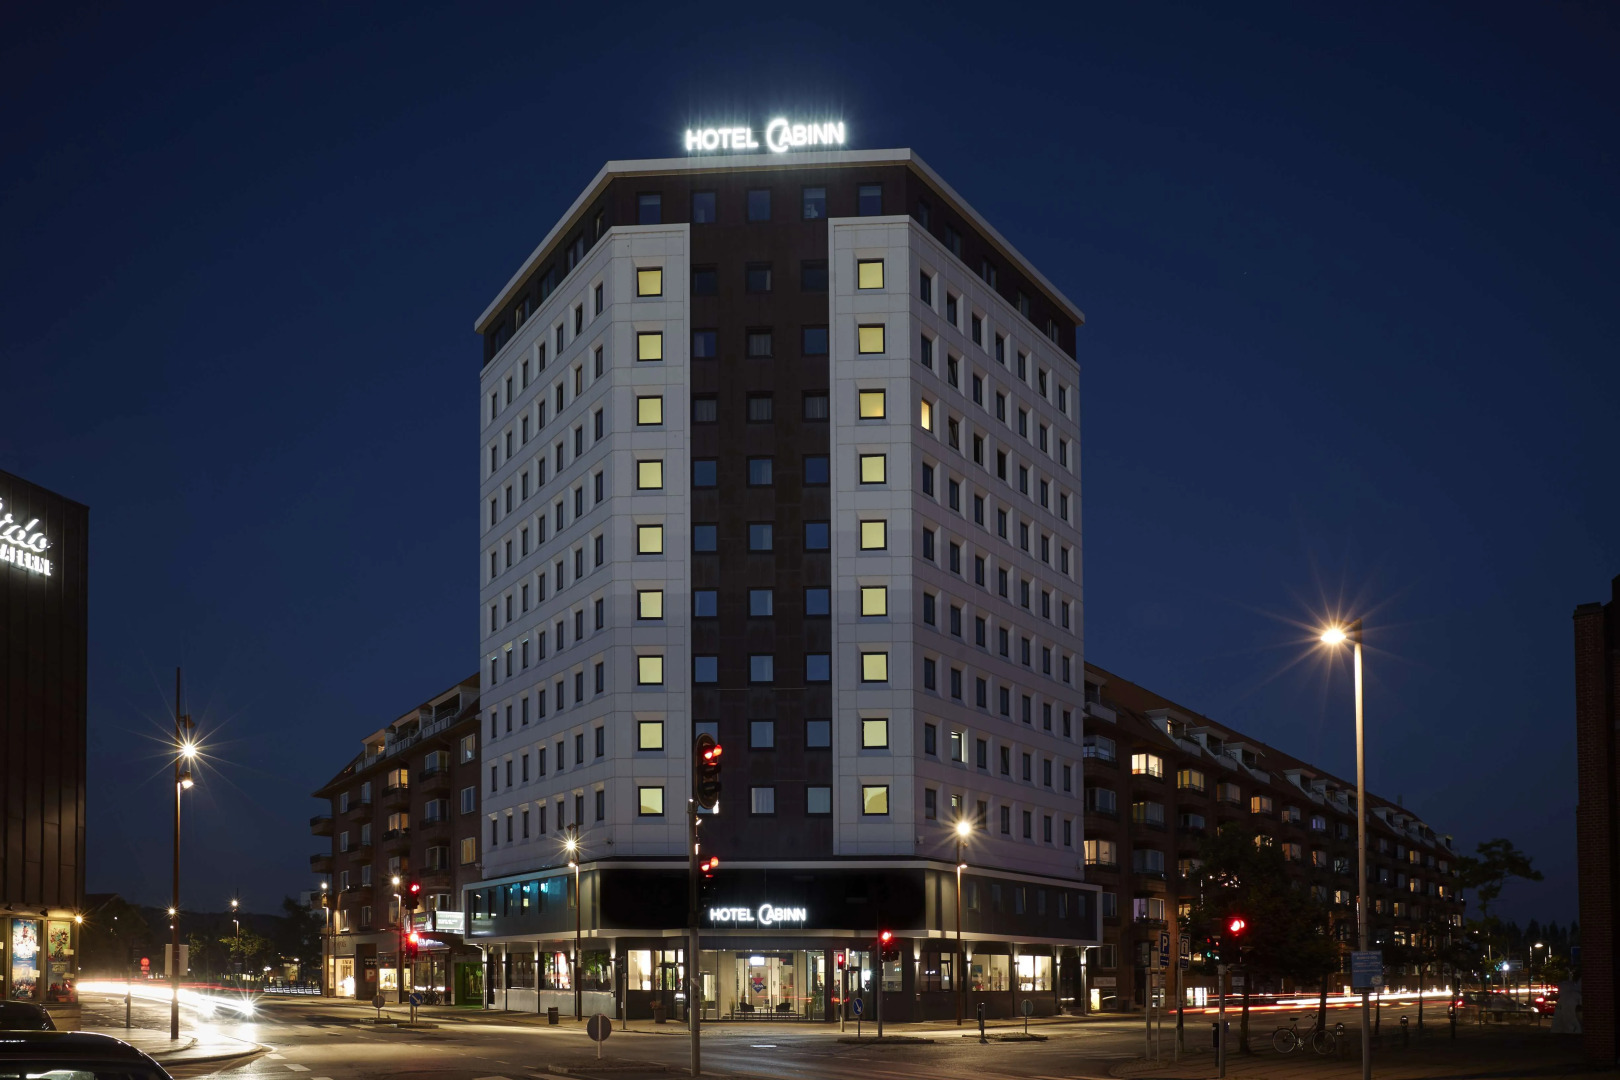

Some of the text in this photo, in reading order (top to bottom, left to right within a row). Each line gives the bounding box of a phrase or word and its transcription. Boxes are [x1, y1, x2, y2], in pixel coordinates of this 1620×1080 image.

[685, 117, 845, 153] HOTEL CABINN
[710, 904, 806, 925] HOTEL CABINN
[366, 968, 375, 980] P
